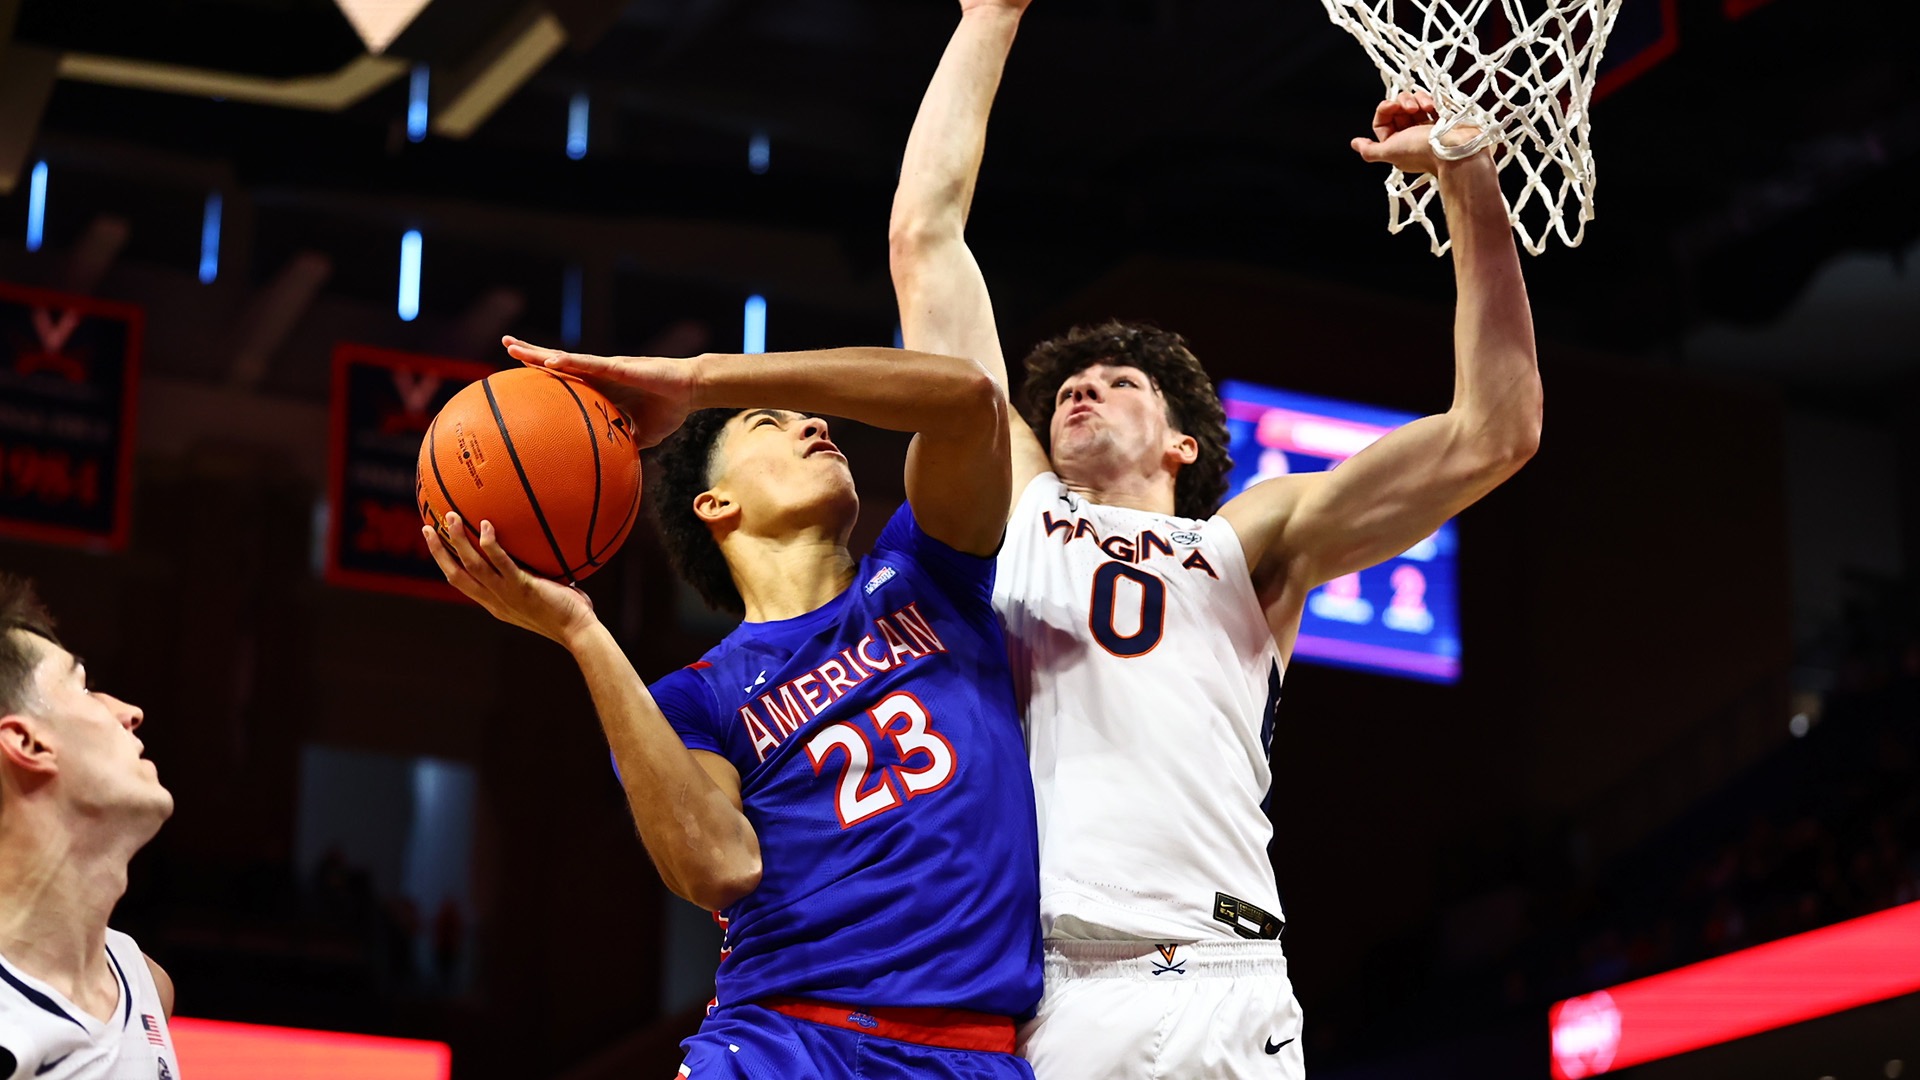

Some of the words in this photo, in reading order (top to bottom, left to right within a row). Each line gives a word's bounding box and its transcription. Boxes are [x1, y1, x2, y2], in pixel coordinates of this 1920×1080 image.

[1088, 560, 1166, 658] 0
[738, 601, 949, 764] AMERICAN
[803, 690, 957, 829] 23
